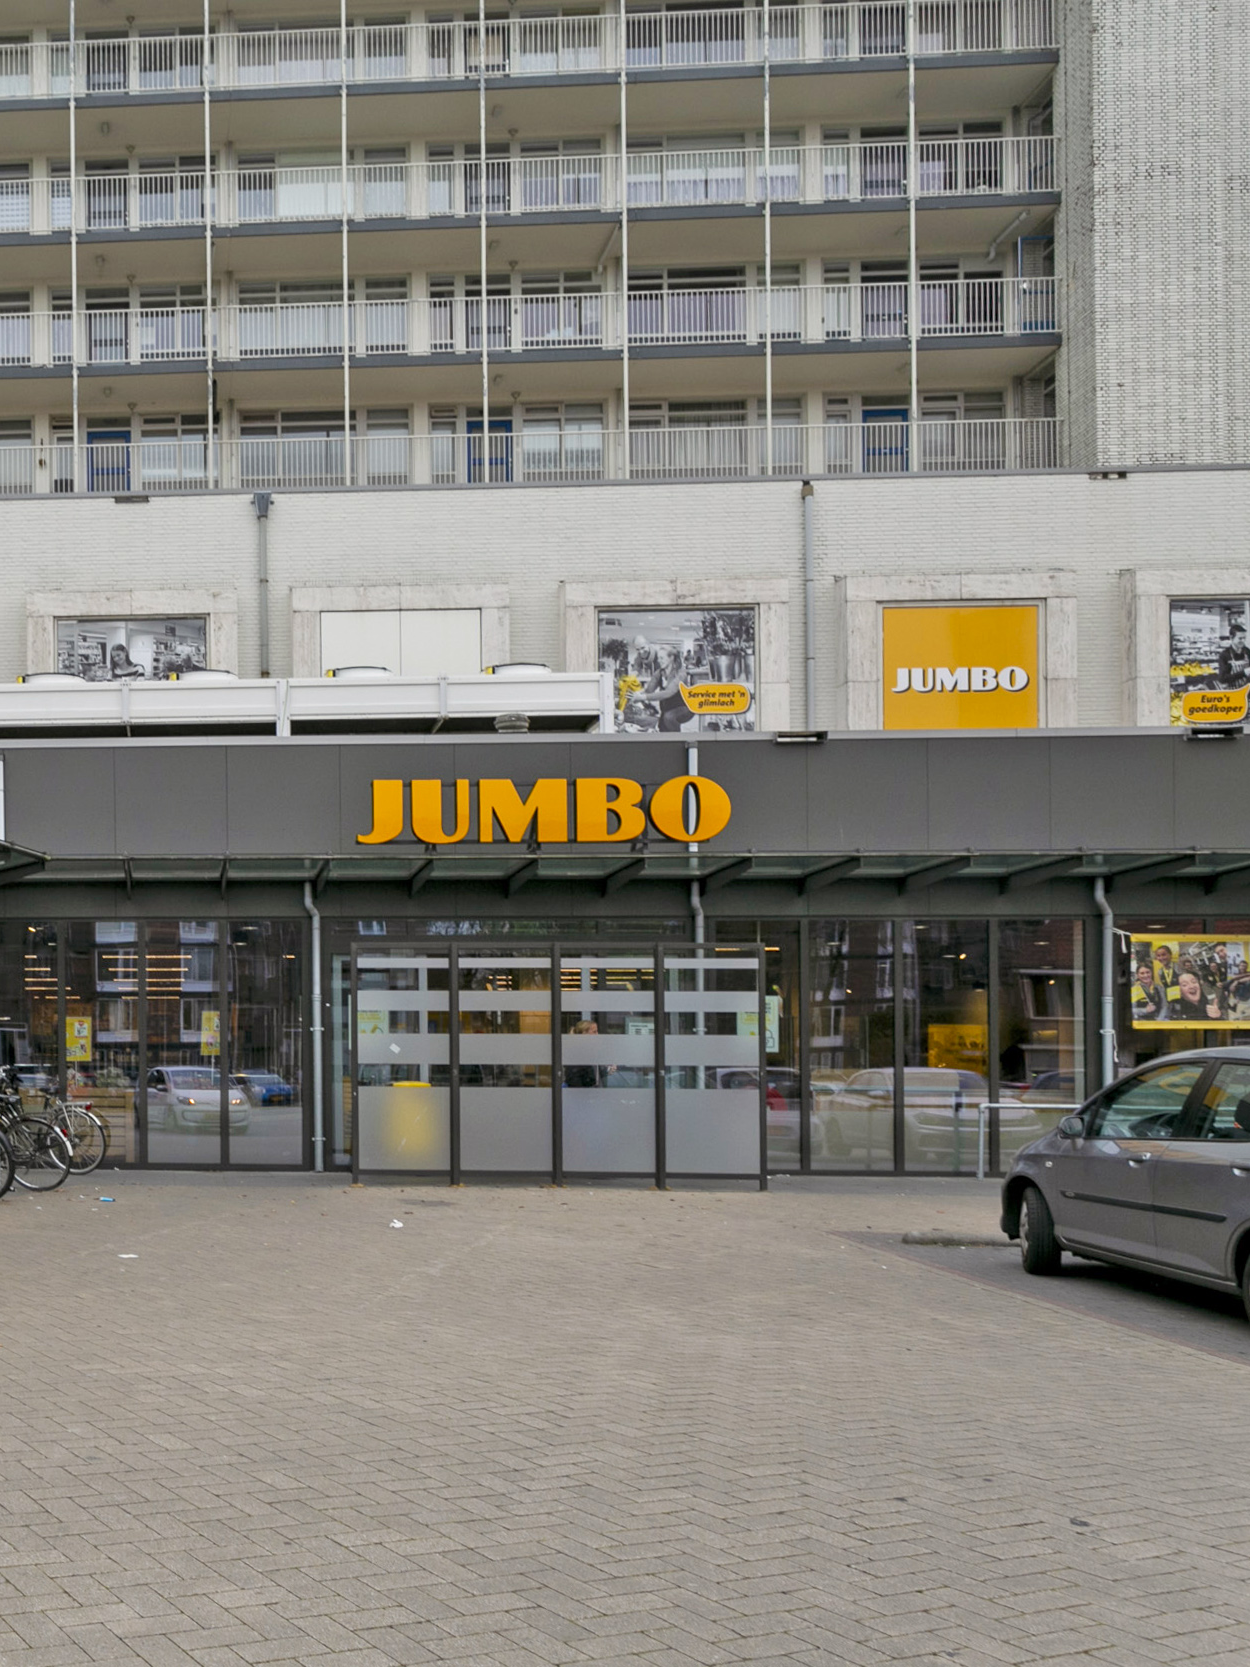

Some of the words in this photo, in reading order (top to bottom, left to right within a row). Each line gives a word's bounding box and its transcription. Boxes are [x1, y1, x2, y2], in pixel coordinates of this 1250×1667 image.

[891, 666, 1030, 693] JUMBO
[688, 690, 717, 698] Service
[718, 690, 736, 698] met
[1200, 694, 1231, 703] Euro's
[698, 699, 735, 709] glimlach
[1188, 704, 1243, 715] goedkoper
[356, 775, 732, 844] JUMBO
